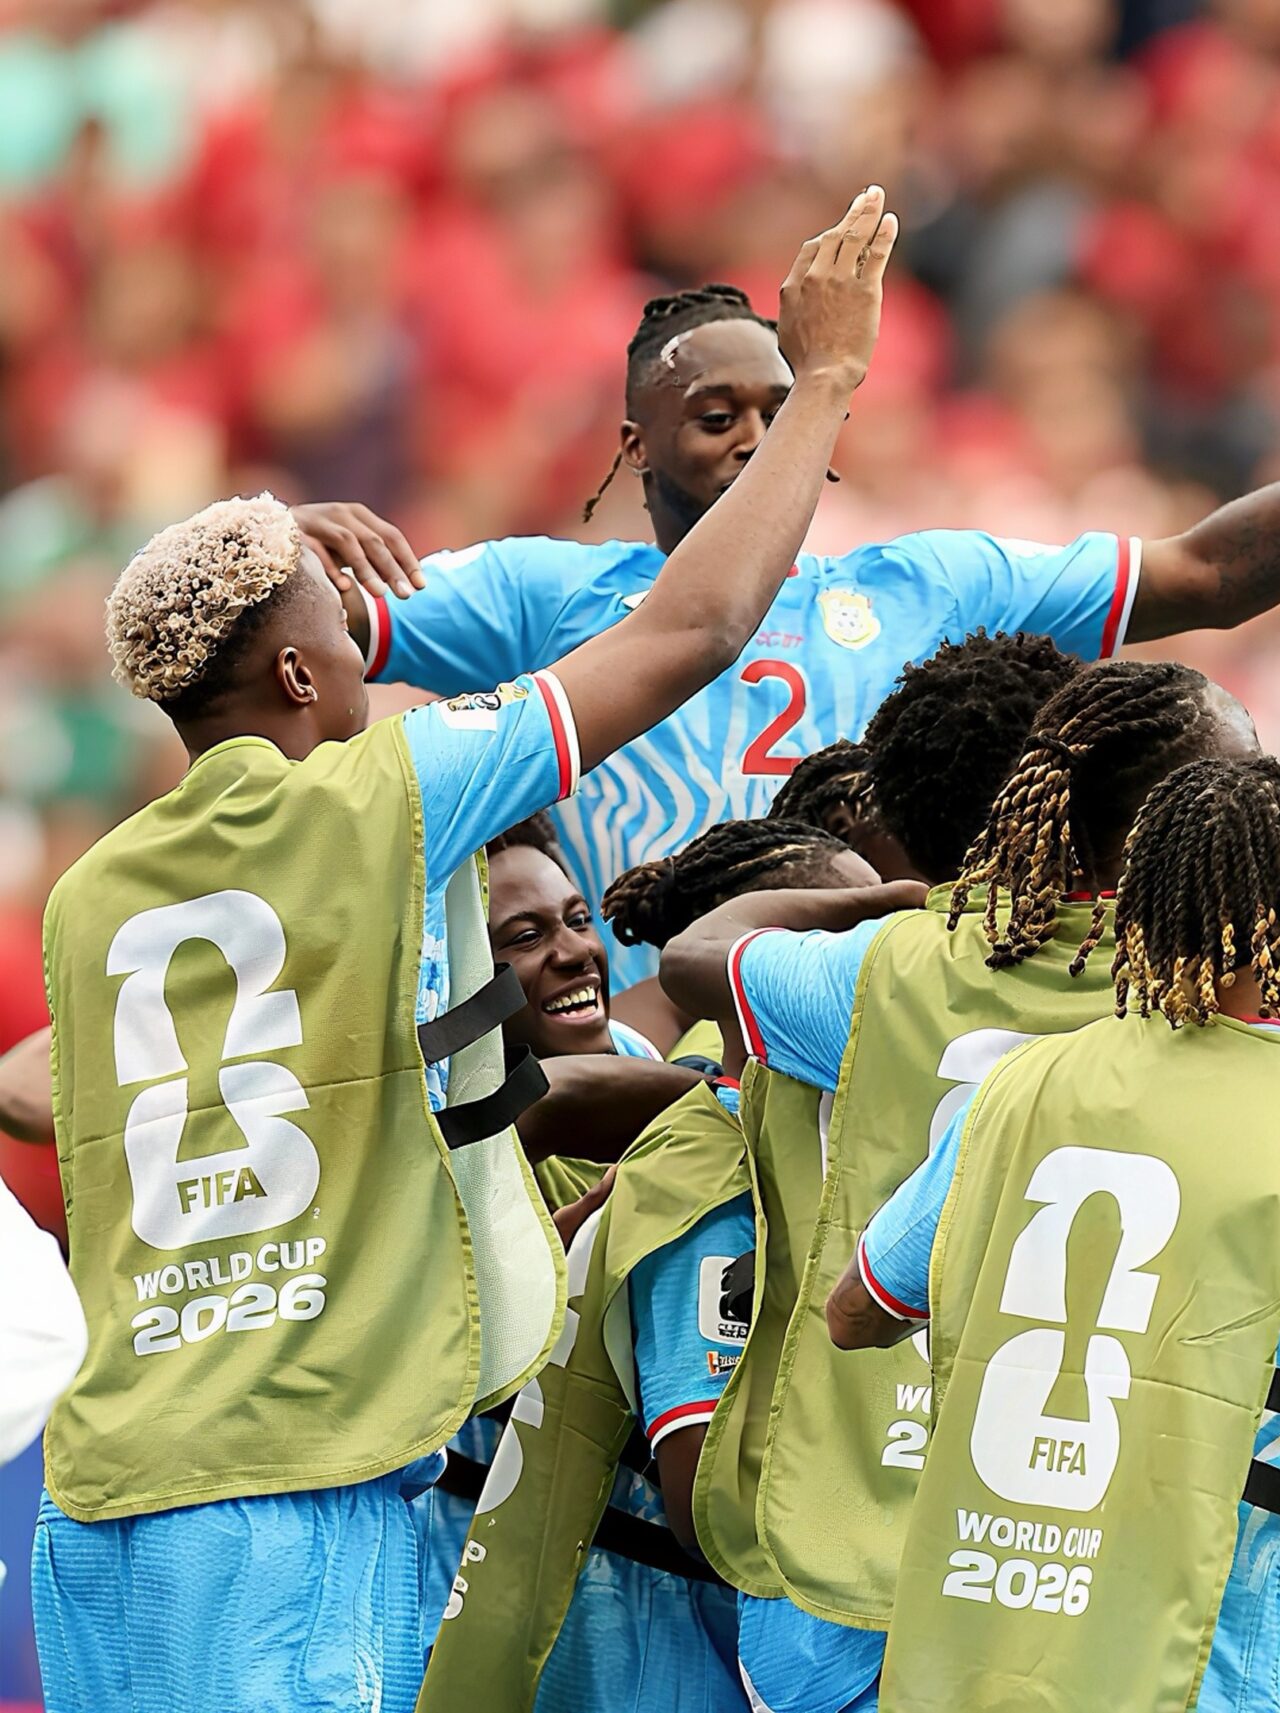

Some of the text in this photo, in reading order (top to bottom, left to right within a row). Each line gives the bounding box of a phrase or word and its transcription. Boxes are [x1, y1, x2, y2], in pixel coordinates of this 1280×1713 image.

[740, 659, 806, 776] 2
[176, 1167, 268, 1214] FIFA
[133, 1237, 327, 1302] WORLD CUP
[130, 1273, 328, 1357] 2026
[1028, 1436, 1086, 1475] FIFA
[956, 1508, 1104, 1559] WORLD CUP
[941, 1548, 1094, 1617] 2026
